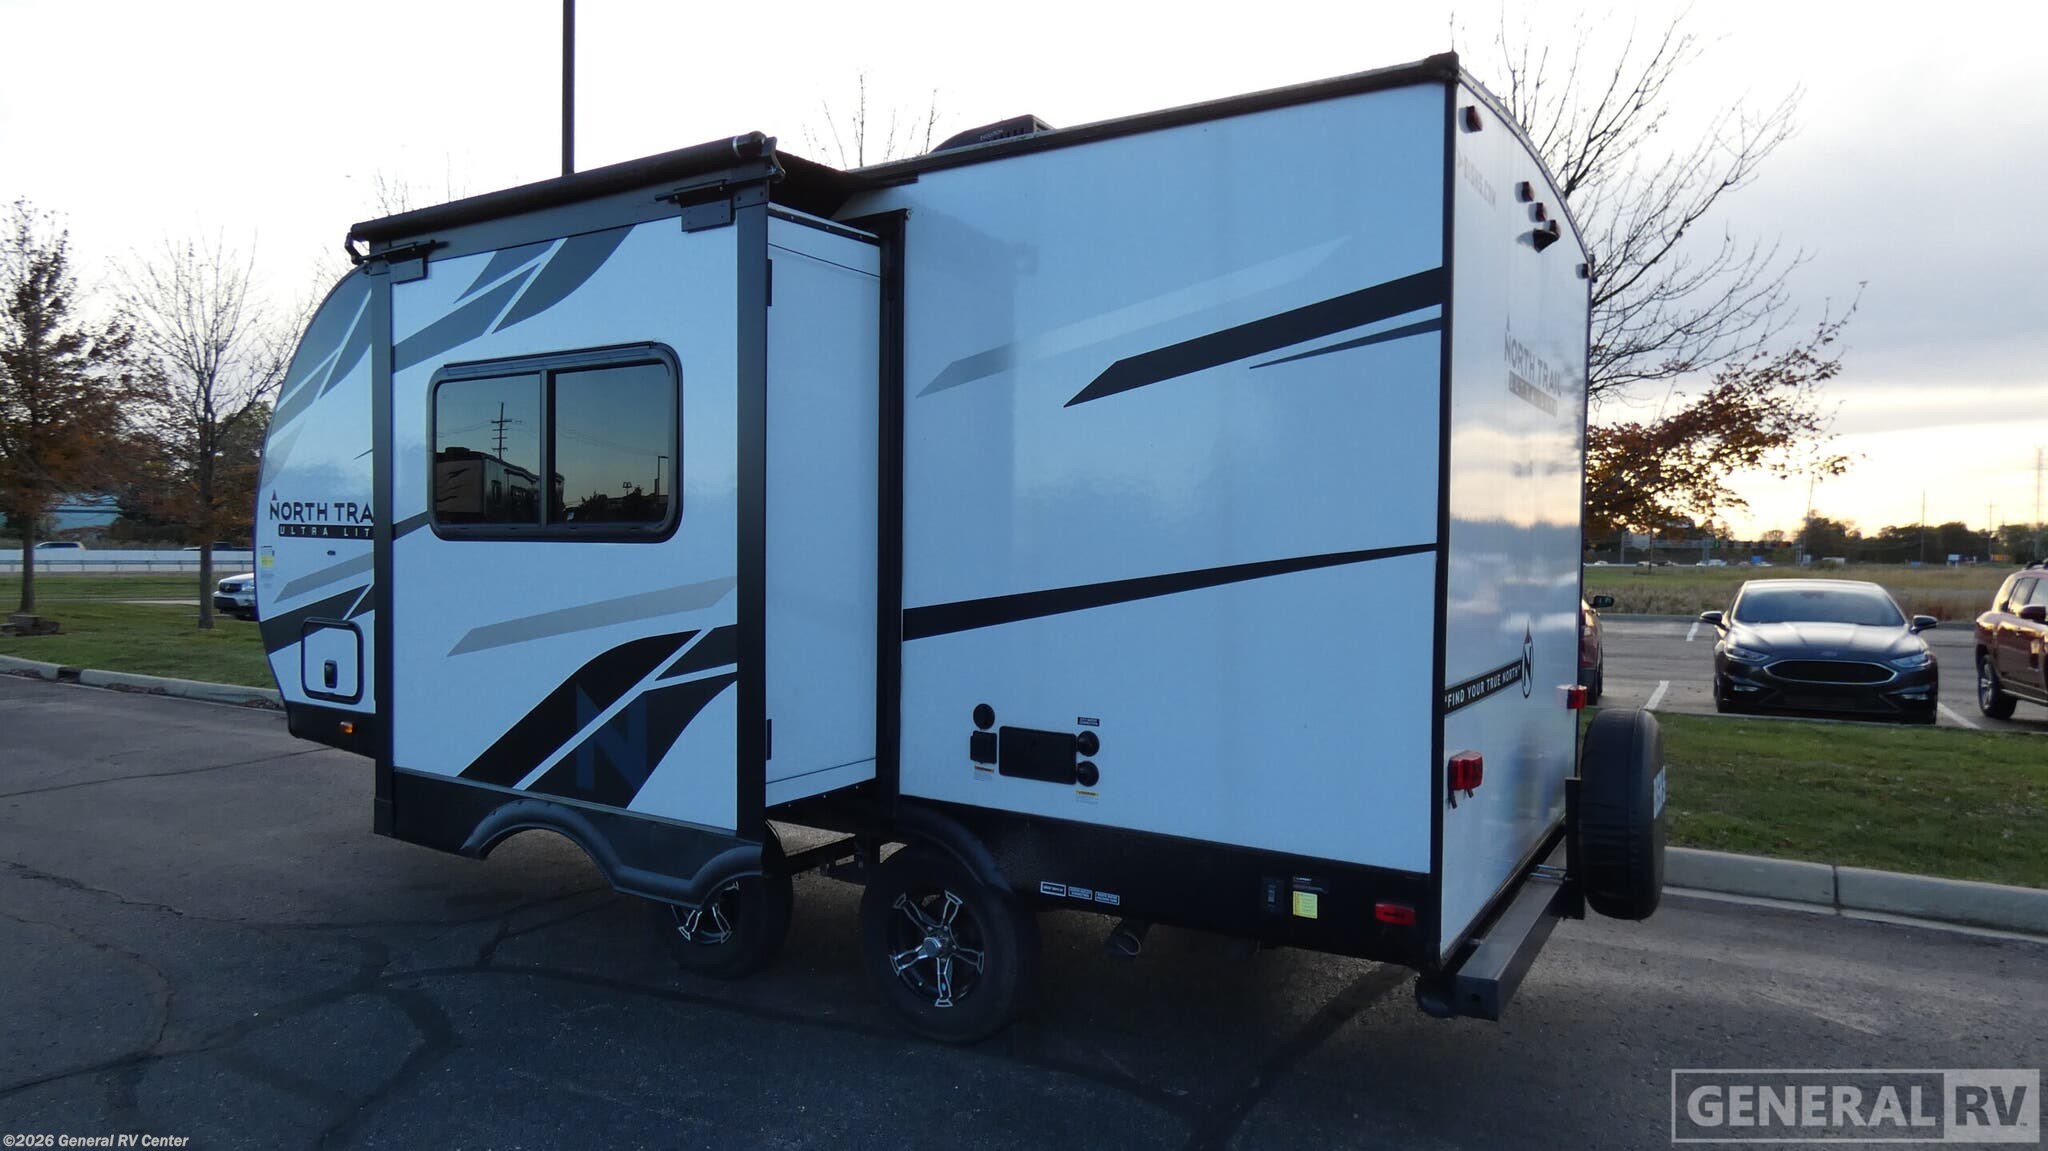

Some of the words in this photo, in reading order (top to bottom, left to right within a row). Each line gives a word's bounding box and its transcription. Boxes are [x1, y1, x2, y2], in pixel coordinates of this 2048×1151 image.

[1504, 331, 1535, 383] NORTH
[1537, 357, 1562, 398] TRAIL
[270, 502, 328, 524] NORTH
[334, 502, 374, 525] TRA
[279, 526, 329, 537] ULTRA
[343, 528, 371, 538] LIT
[1467, 681, 1485, 699] YOUR
[1486, 674, 1501, 691] TRUE
